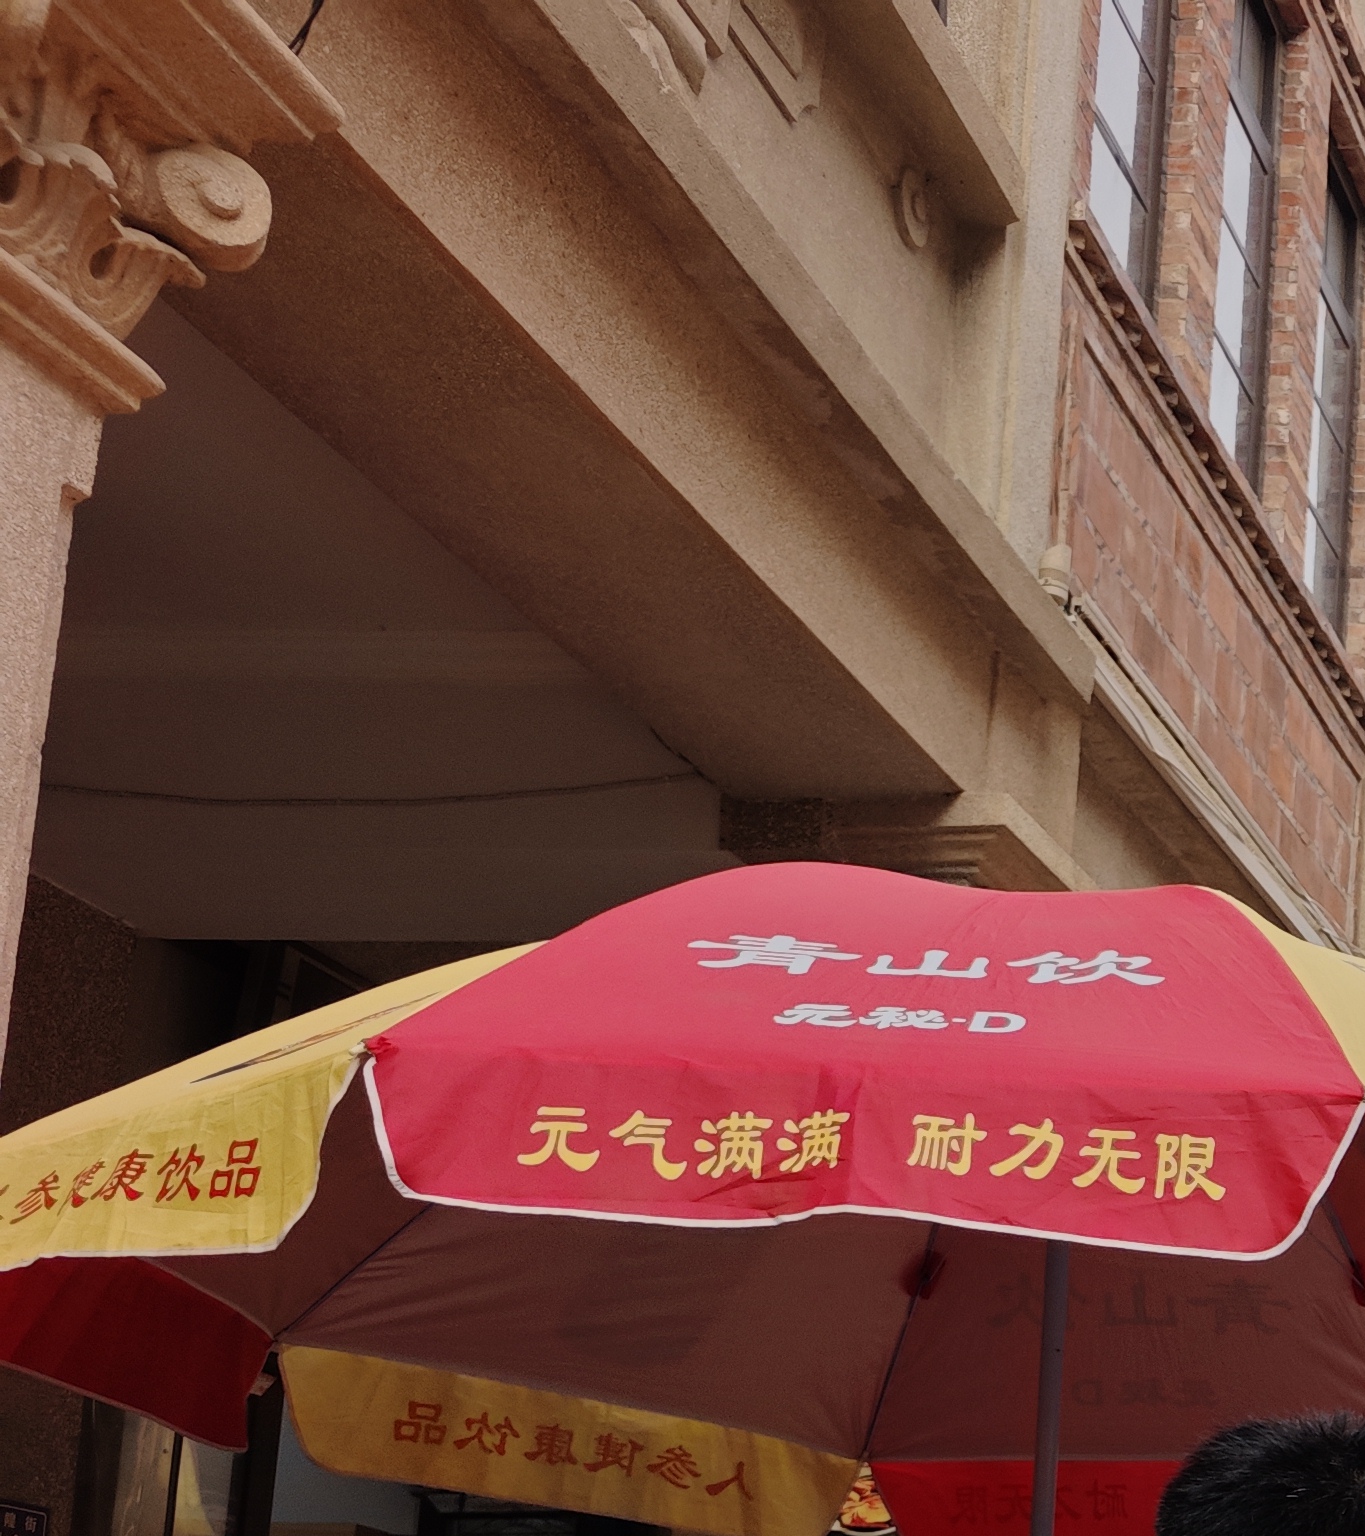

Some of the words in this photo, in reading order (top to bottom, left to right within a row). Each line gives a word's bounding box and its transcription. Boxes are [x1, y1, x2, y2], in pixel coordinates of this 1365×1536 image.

[687, 934, 1166, 986] 青山饮
[517, 1108, 852, 1181] 元气满满
[907, 1113, 1226, 1201] 耐力无限
